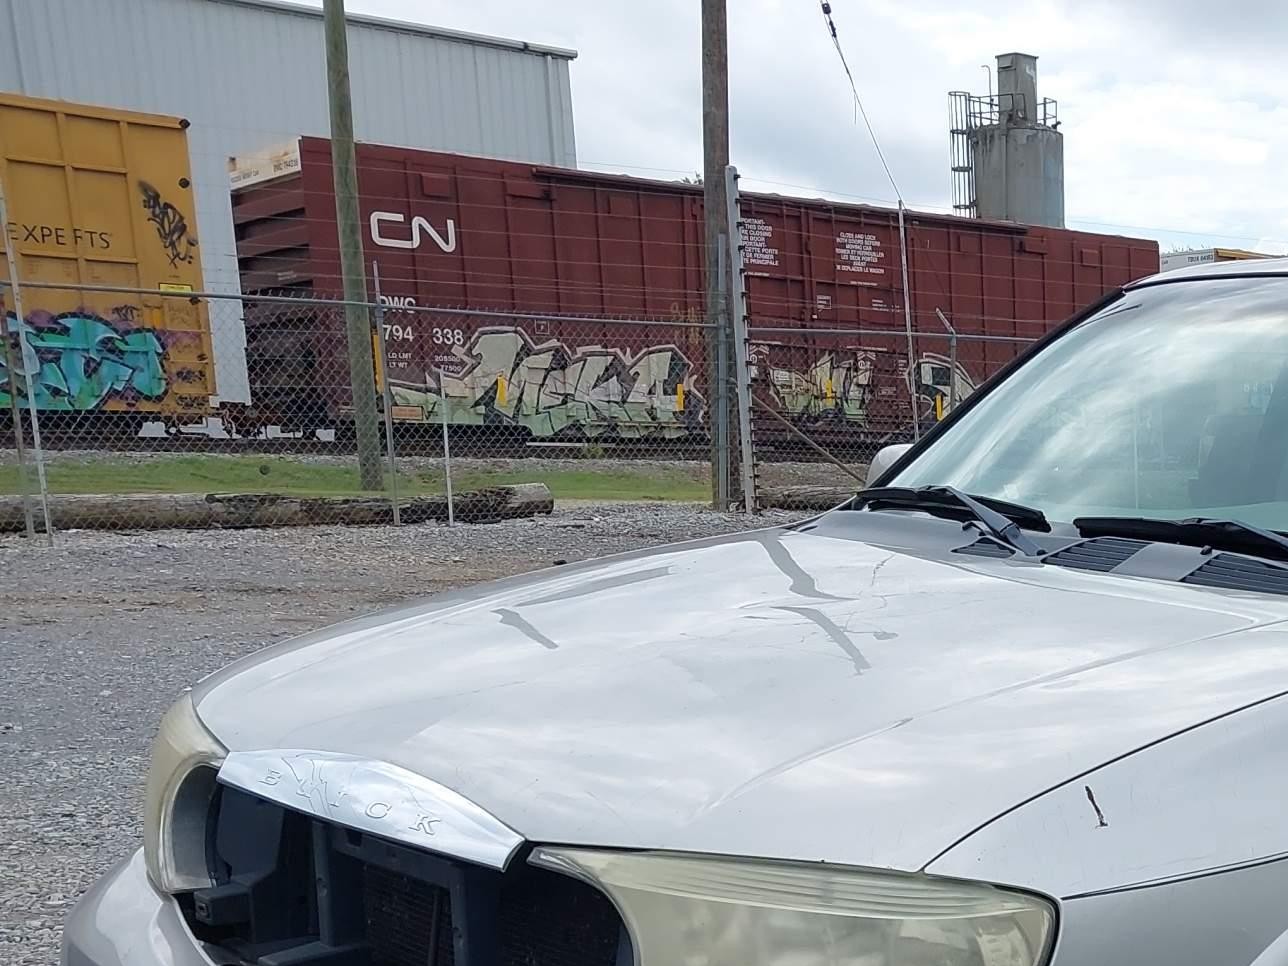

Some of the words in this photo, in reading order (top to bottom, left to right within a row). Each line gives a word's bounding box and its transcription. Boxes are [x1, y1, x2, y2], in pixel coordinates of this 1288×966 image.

[370, 211, 456, 253] CN
[382, 324, 415, 342] 794
[432, 327, 464, 345] 338
